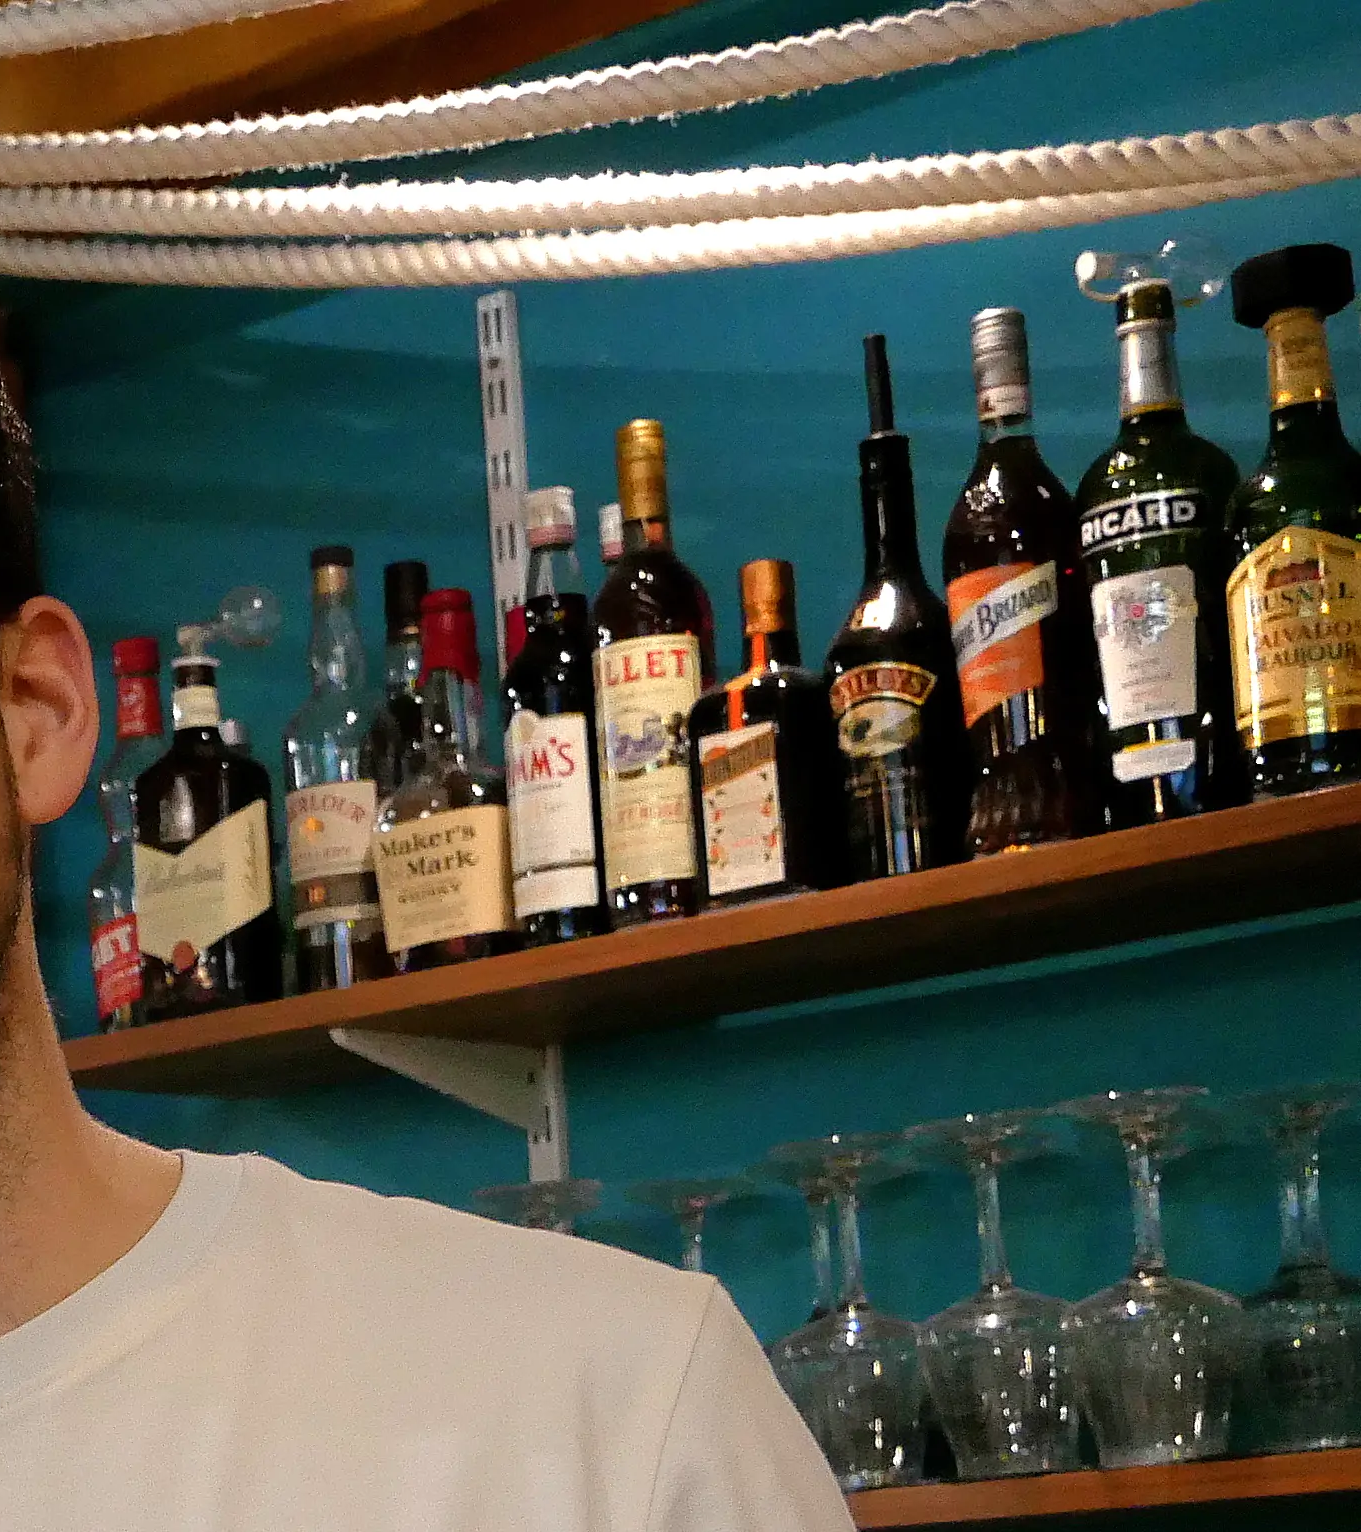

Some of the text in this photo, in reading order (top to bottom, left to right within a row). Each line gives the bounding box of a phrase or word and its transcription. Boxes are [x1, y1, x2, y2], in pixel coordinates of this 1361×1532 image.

[1080, 499, 1197, 548] RICARD
[379, 824, 476, 858] Maker's
[406, 848, 478, 876] Mark
